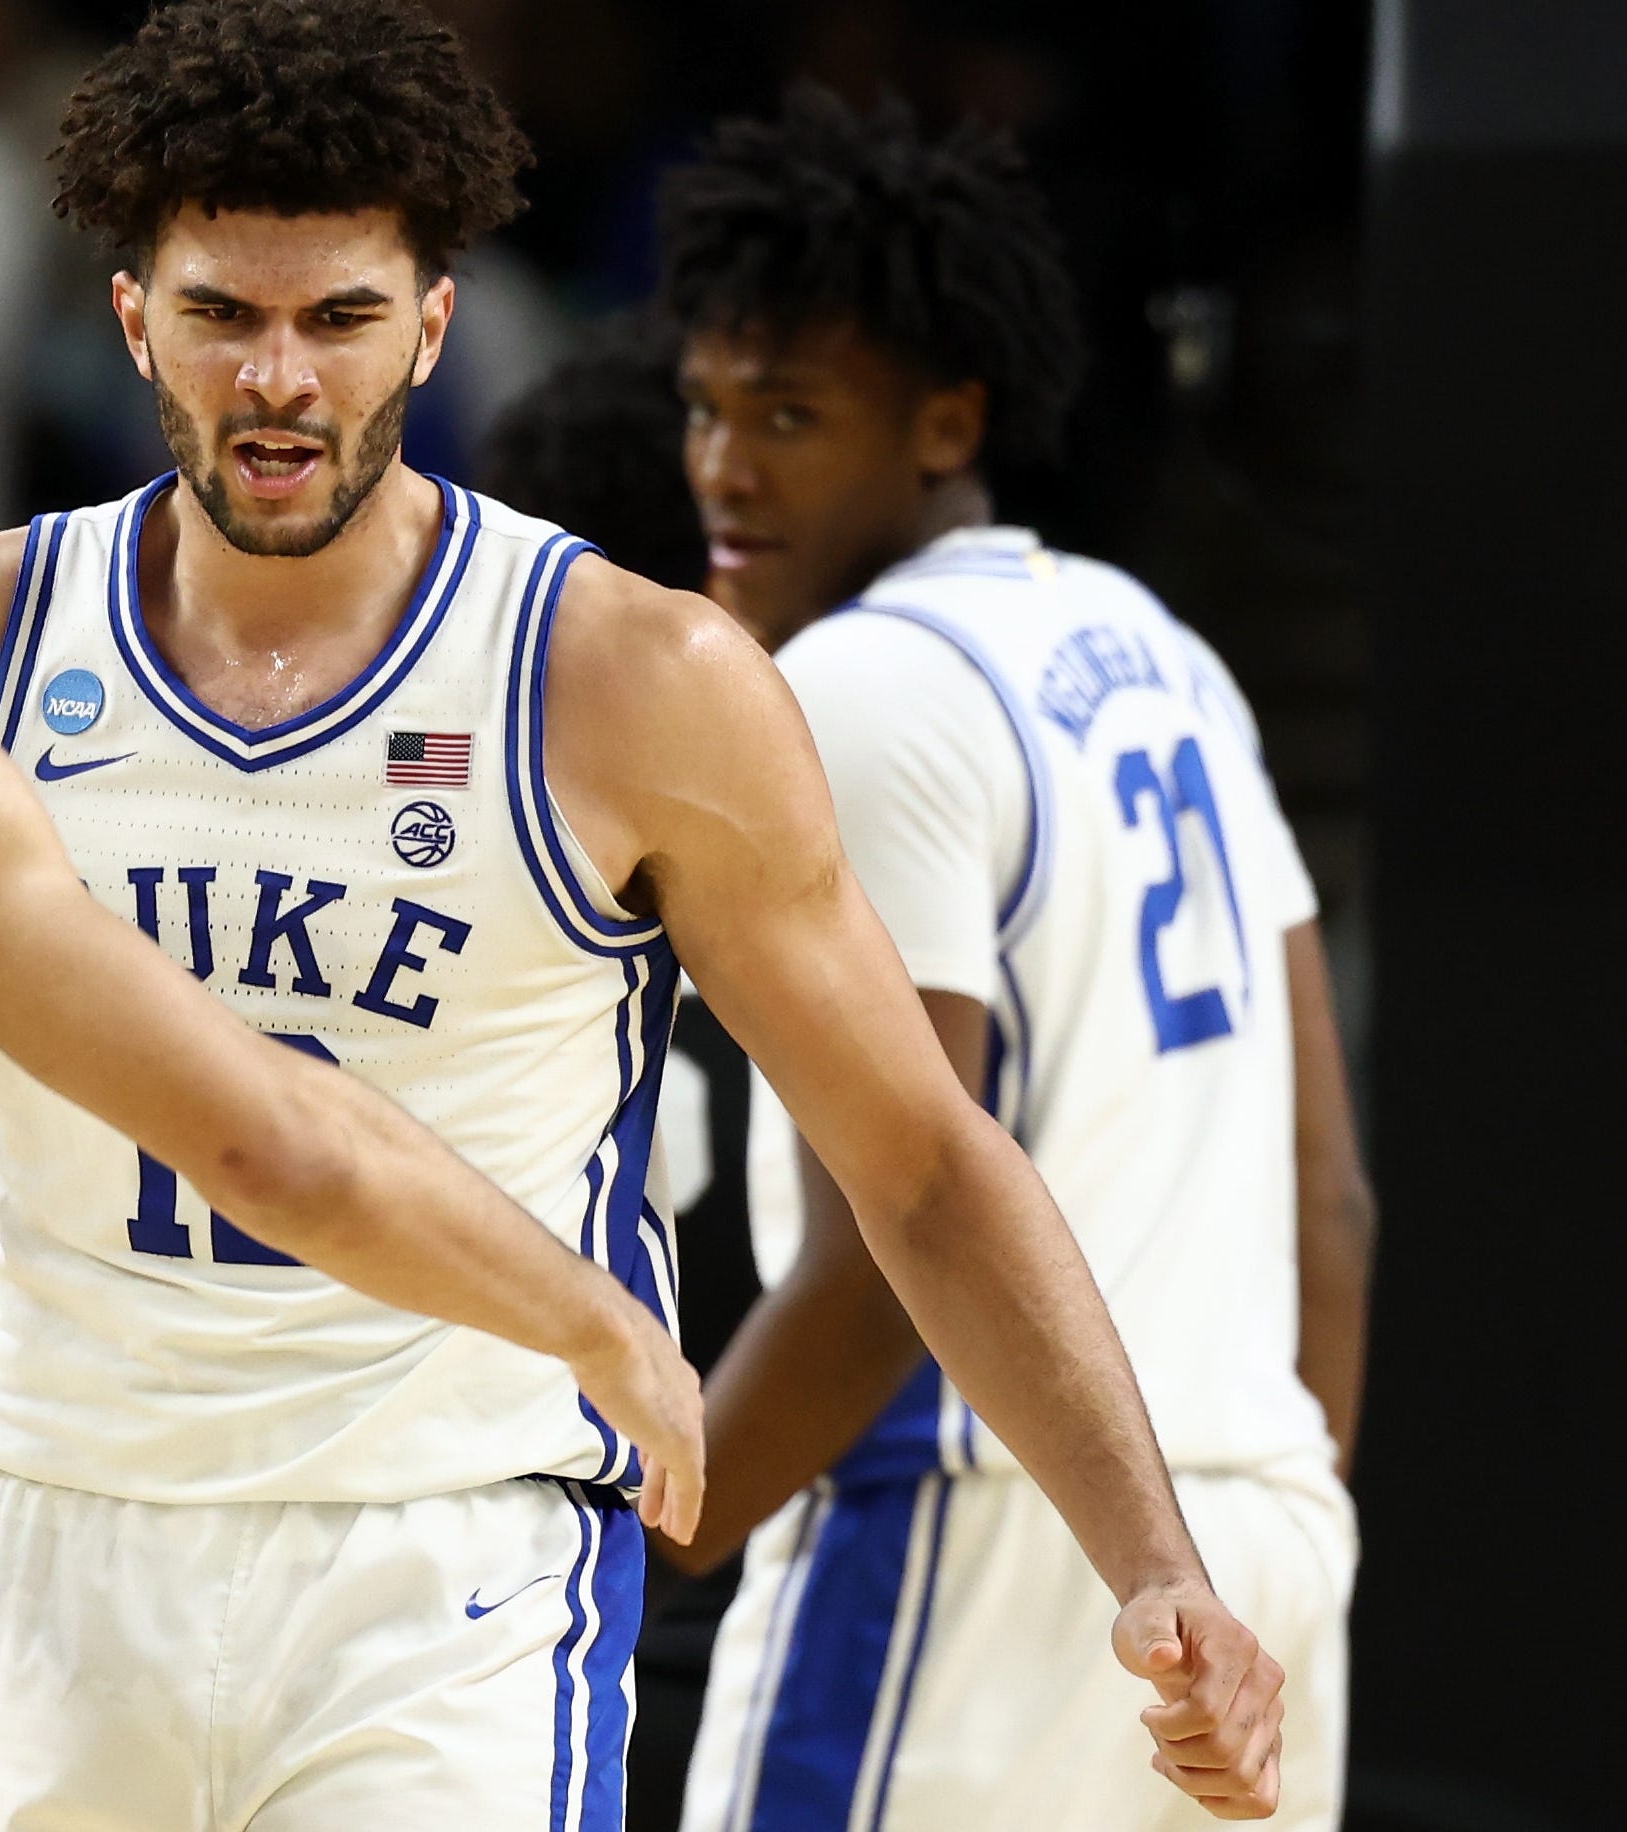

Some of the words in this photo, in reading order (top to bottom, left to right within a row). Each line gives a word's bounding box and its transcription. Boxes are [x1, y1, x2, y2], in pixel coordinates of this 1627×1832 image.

[46, 697, 98, 720] NCAA
[400, 822, 454, 842] ACC
[1112, 734, 1249, 1056] 21
[78, 866, 473, 1029] UKE
